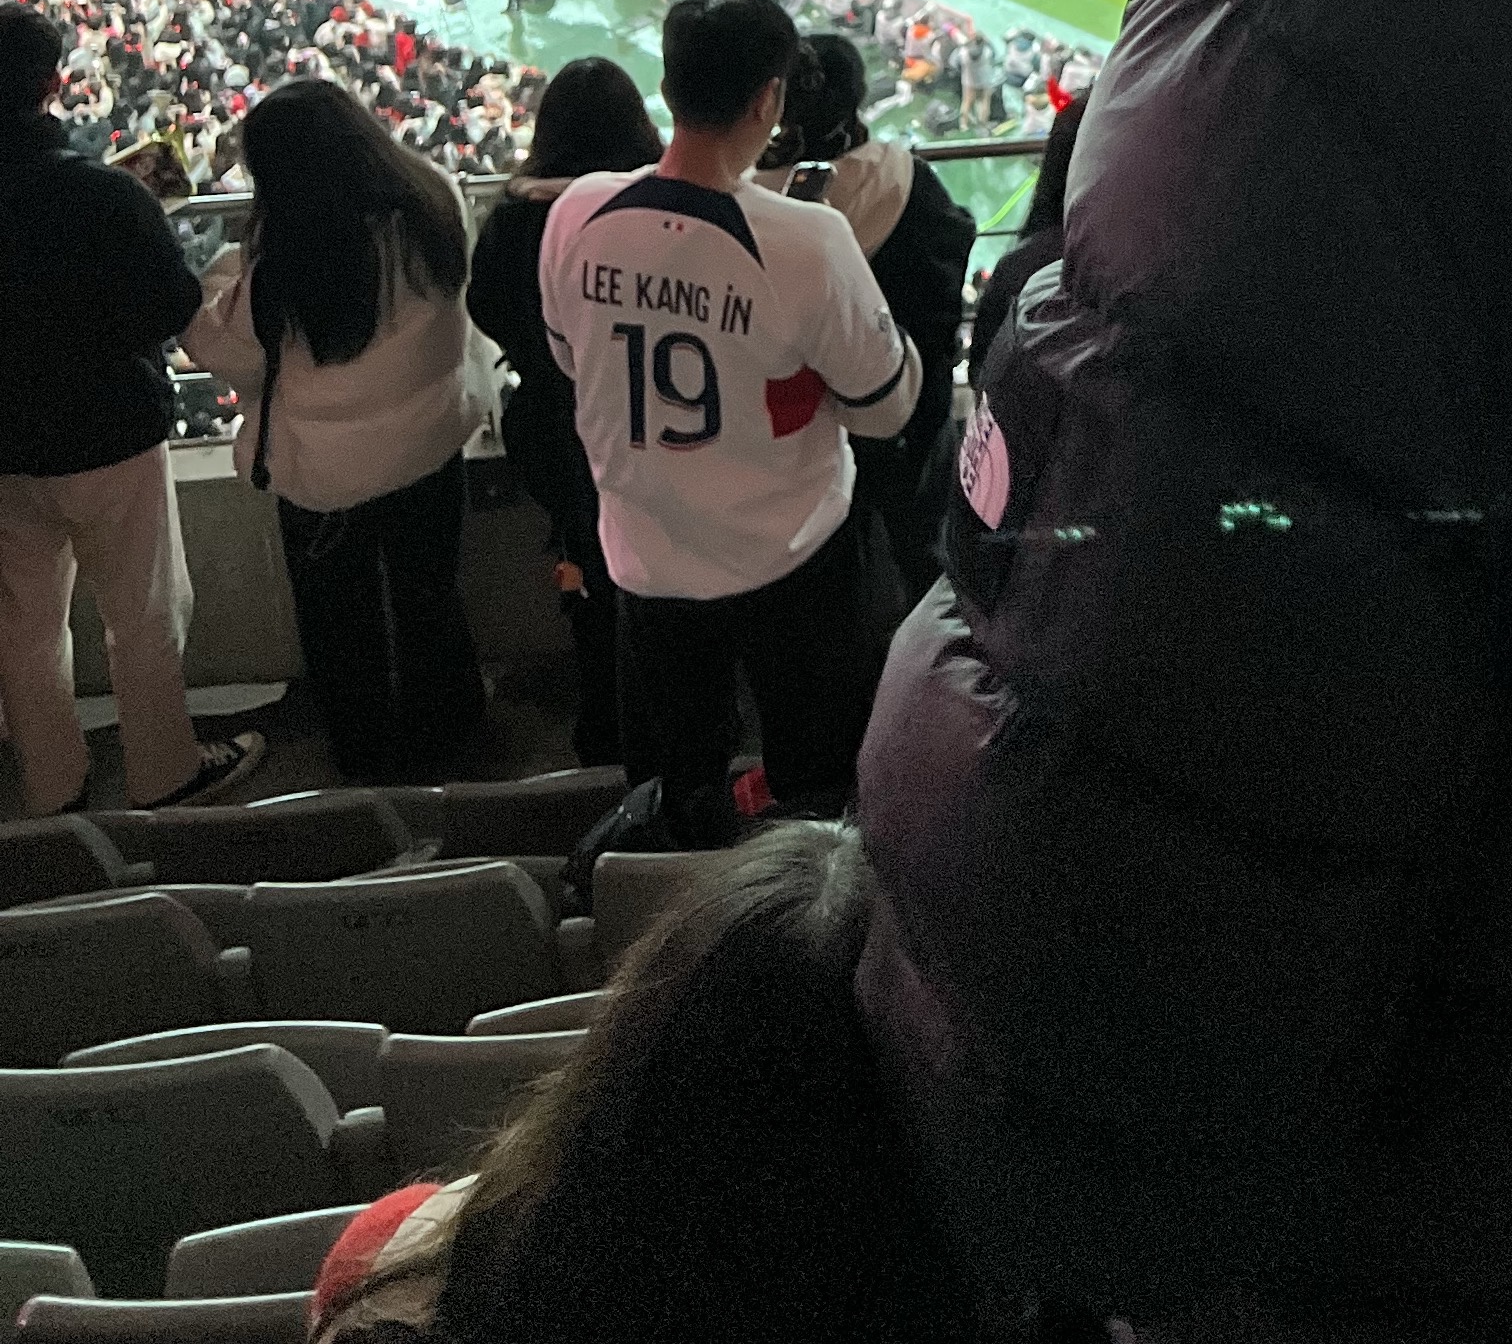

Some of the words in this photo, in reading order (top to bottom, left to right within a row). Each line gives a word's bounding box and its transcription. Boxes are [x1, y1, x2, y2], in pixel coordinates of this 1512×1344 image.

[582, 259, 623, 307] LEE
[635, 272, 710, 324] KANG
[610, 322, 722, 451] 19
